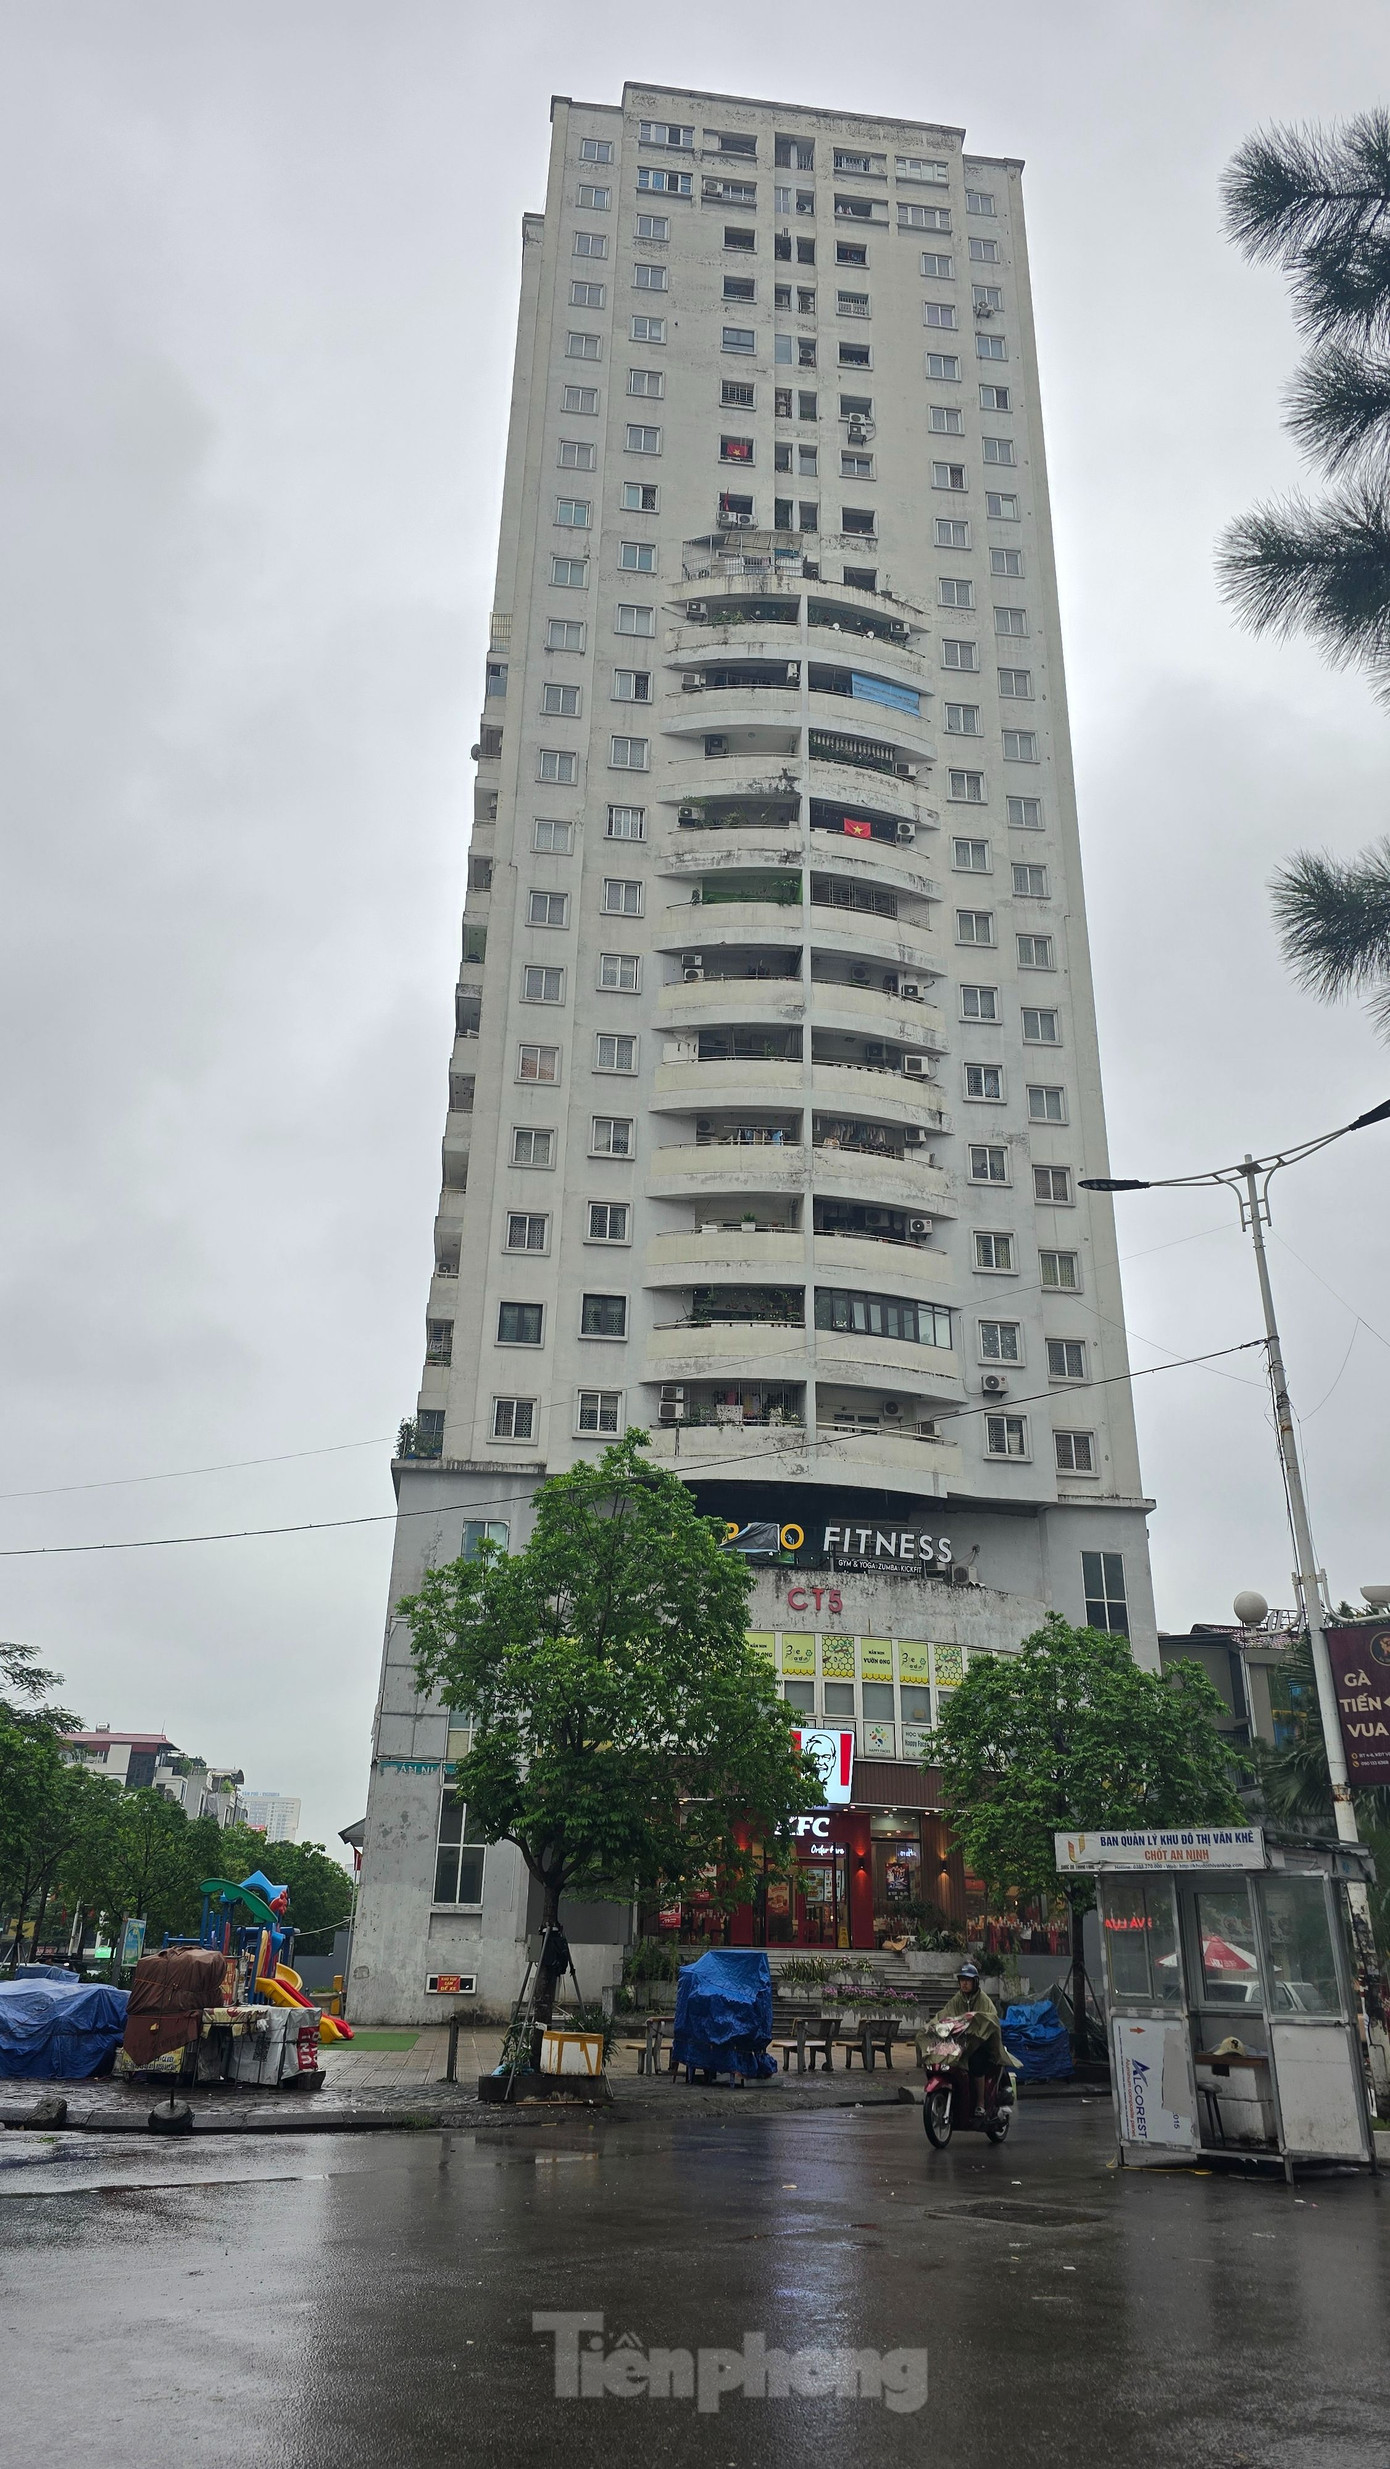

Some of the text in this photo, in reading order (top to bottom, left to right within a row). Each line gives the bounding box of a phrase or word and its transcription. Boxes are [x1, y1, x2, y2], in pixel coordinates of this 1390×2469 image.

[823, 1526, 953, 1563] FITNESS
[838, 1559, 852, 1567] GYM
[852, 1560, 859, 1568] &
[860, 1561, 876, 1569] YOGA
[788, 1587, 843, 1613] CT5
[1344, 1669, 1372, 1687] GÀ
[1339, 1693, 1383, 1712] TIẾN
[1347, 1722, 1390, 1738] VUA
[1100, 1836, 1119, 1847] BAN
[1121, 1832, 1145, 1848] QUẢN
[1160, 1834, 1179, 1846] KHU
[1181, 1832, 1194, 1845] ĐÔ
[1196, 1834, 1211, 1847] THỊ
[1213, 1831, 1233, 1844] VĂN
[1235, 1830, 1254, 1843] KHÊ
[1144, 1846, 1209, 1860] CHỐT AN NINH
[1131, 2058, 1150, 2139] ALCOREST
